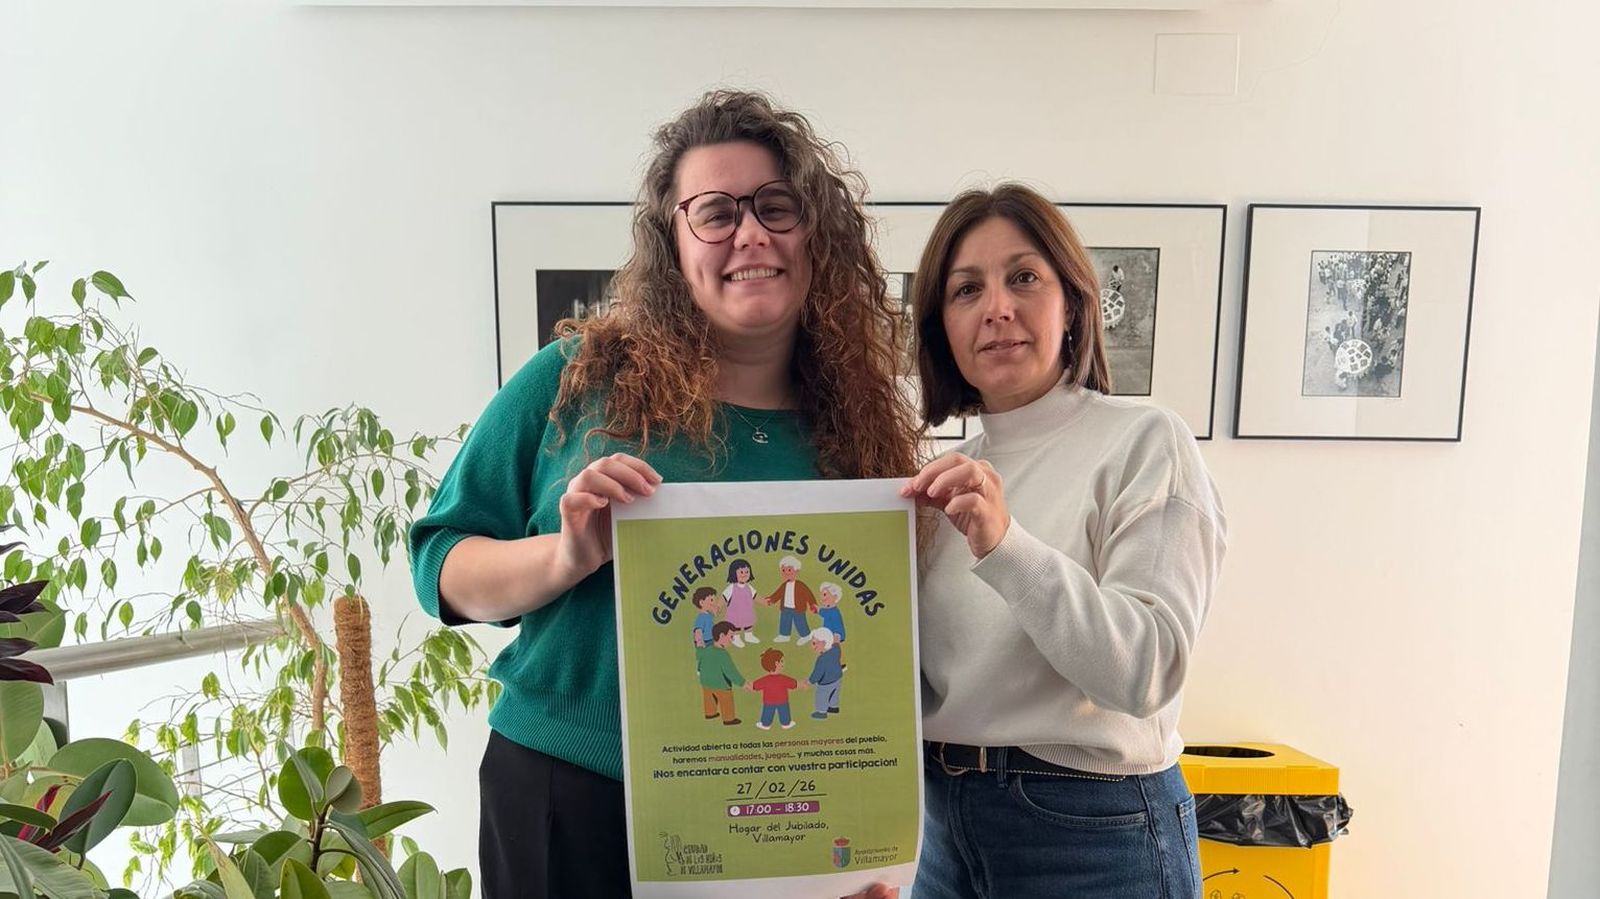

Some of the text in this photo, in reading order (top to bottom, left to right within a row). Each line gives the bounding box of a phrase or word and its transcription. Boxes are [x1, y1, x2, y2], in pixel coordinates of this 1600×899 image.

[652, 529, 885, 625] GENERACIONES UNIDAS
[662, 744, 700, 753] Actividad
[701, 743, 731, 751] abierta
[740, 741, 761, 749] todas
[774, 740, 809, 748] personas
[810, 738, 844, 746] mayores
[845, 736, 858, 744] del
[858, 735, 887, 744] pueblo,
[672, 756, 707, 764] haremos
[708, 753, 764, 762] manualidades,
[803, 749, 833, 757] muchas
[834, 748, 856, 756] cosas
[731, 764, 765, 774] contar
[767, 764, 785, 772] con
[788, 762, 826, 772] vuestra
[828, 758, 898, 770] participación!
[729, 820, 829, 836] Hogar del Jubilado,
[752, 834, 806, 844] Villamayor
[854, 854, 897, 865] Villamayor
